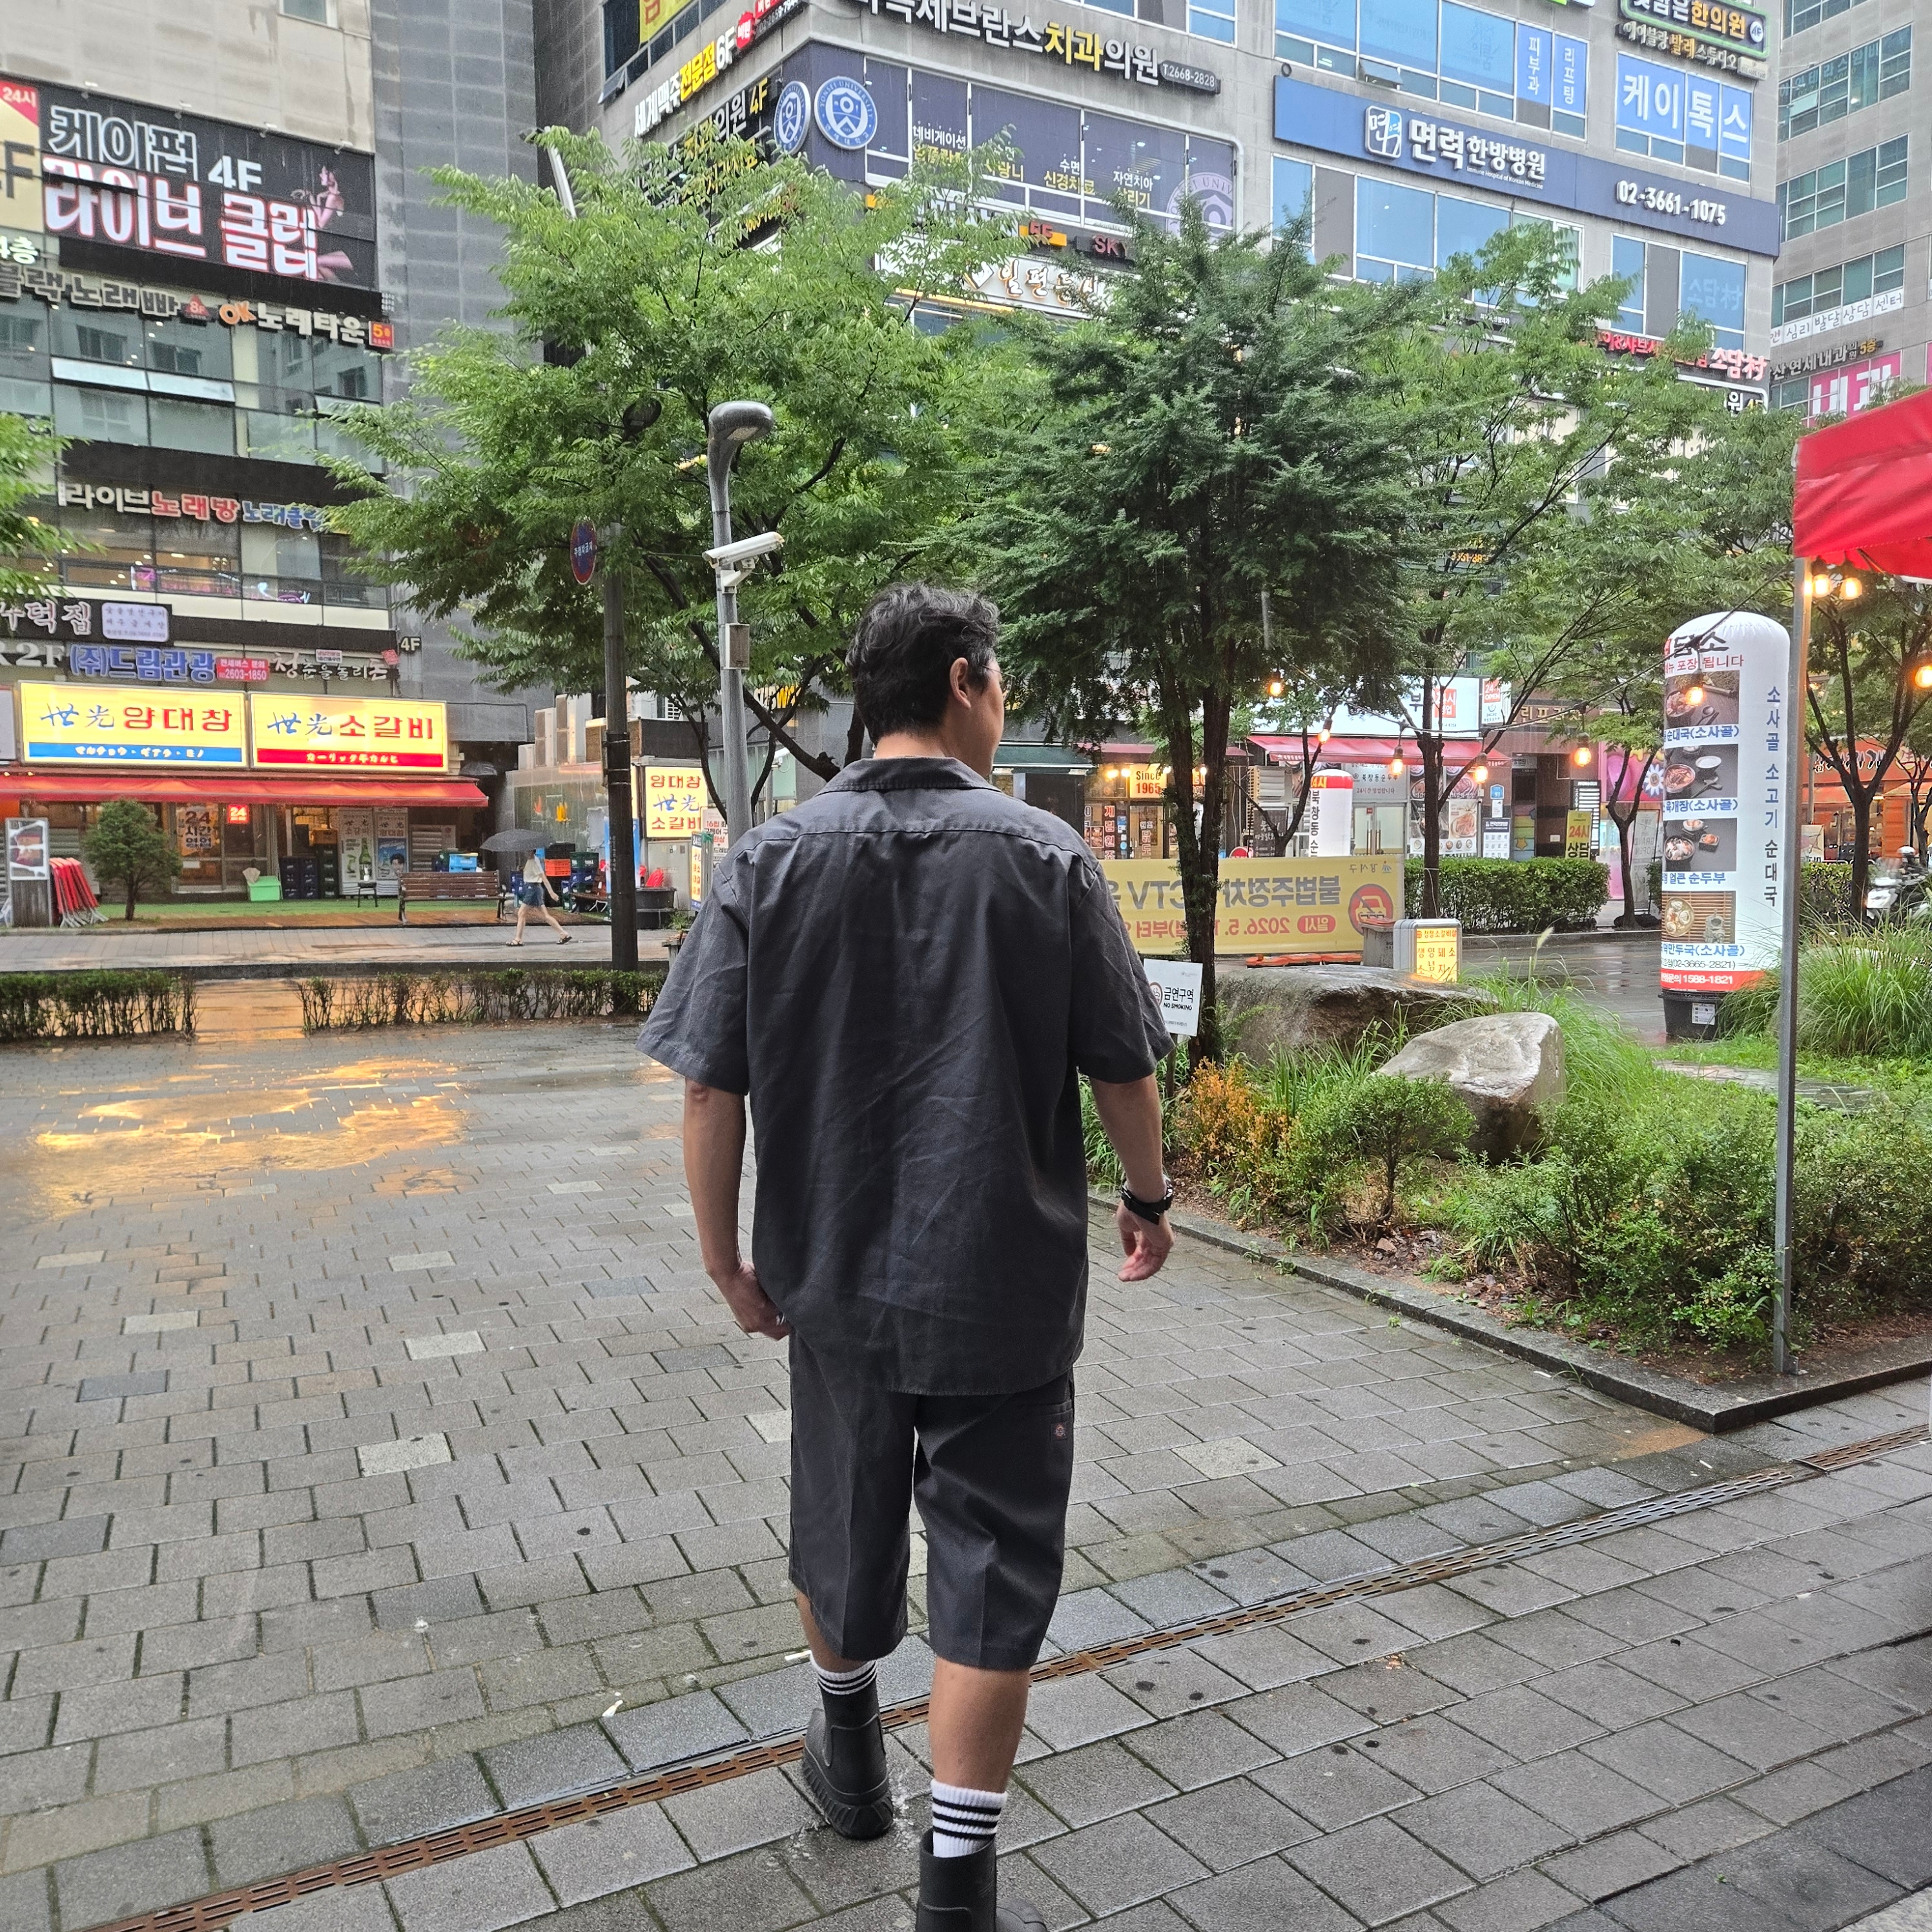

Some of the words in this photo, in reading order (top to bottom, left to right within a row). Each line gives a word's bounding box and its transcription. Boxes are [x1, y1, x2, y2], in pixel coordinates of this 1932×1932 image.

[716, 26, 735, 70] 6F
[1527, 37, 1541, 96] 피부과
[1563, 47, 1576, 105] 리프팅
[3, 87, 37, 108] 24시
[750, 77, 768, 114] 4F
[1623, 74, 1747, 143] 케이톡스
[1408, 119, 1464, 170] 면력
[1466, 136, 1545, 181] 한방병원
[0, 140, 35, 199] F
[208, 155, 262, 191] 4F
[1060, 159, 1080, 175] 수면
[1466, 166, 1485, 176] Immune
[1485, 170, 1503, 180] Hospital
[1113, 170, 1153, 191] 자연치아
[1616, 180, 1727, 225] 02-3661-1075
[43, 157, 206, 257] 라이브
[220, 192, 318, 280] 클럽
[220, 300, 257, 325] OK
[258, 303, 365, 344] 노래타운
[1786, 324, 1810, 340] 심리
[1814, 311, 1840, 331] 발달
[1843, 302, 1870, 322] 상담
[1875, 293, 1902, 311] 센터
[1709, 347, 1767, 381] 소담村
[1769, 364, 1785, 380] 산
[400, 637, 421, 652] 4F
[70, 644, 215, 683] (주)드림관광
[1664, 662, 1674, 674] 뉴
[1676, 657, 1698, 672] 포장
[1701, 654, 1745, 669] 됩니다
[1485, 692, 1501, 701] OPEN
[123, 706, 232, 732] 양대창
[340, 715, 433, 739] 소갈비
[1765, 686, 1781, 752] 소사골
[650, 775, 701, 788] 양대창
[1136, 770, 1160, 781] Since
[1136, 782, 1160, 794] 1965
[1764, 763, 1780, 828] 소고기
[185, 810, 211, 824] 24
[230, 807, 247, 817] 24
[1311, 790, 1321, 836] 북창동
[1662, 799, 1739, 813] 육개장(소사골)
[652, 816, 701, 830] 소갈비
[1569, 825, 1590, 838] 24시
[1142, 830, 1152, 859] 닭도
[1310, 840, 1320, 857] 순
[1568, 842, 1590, 858] 상담
[1669, 872, 1687, 885] 얼큰
[1688, 872, 1726, 885] 순두부
[1763, 839, 1779, 907] 순대국
[1683, 974, 1733, 984] 1588-1821
[1164, 987, 1194, 1003] 금연구역
